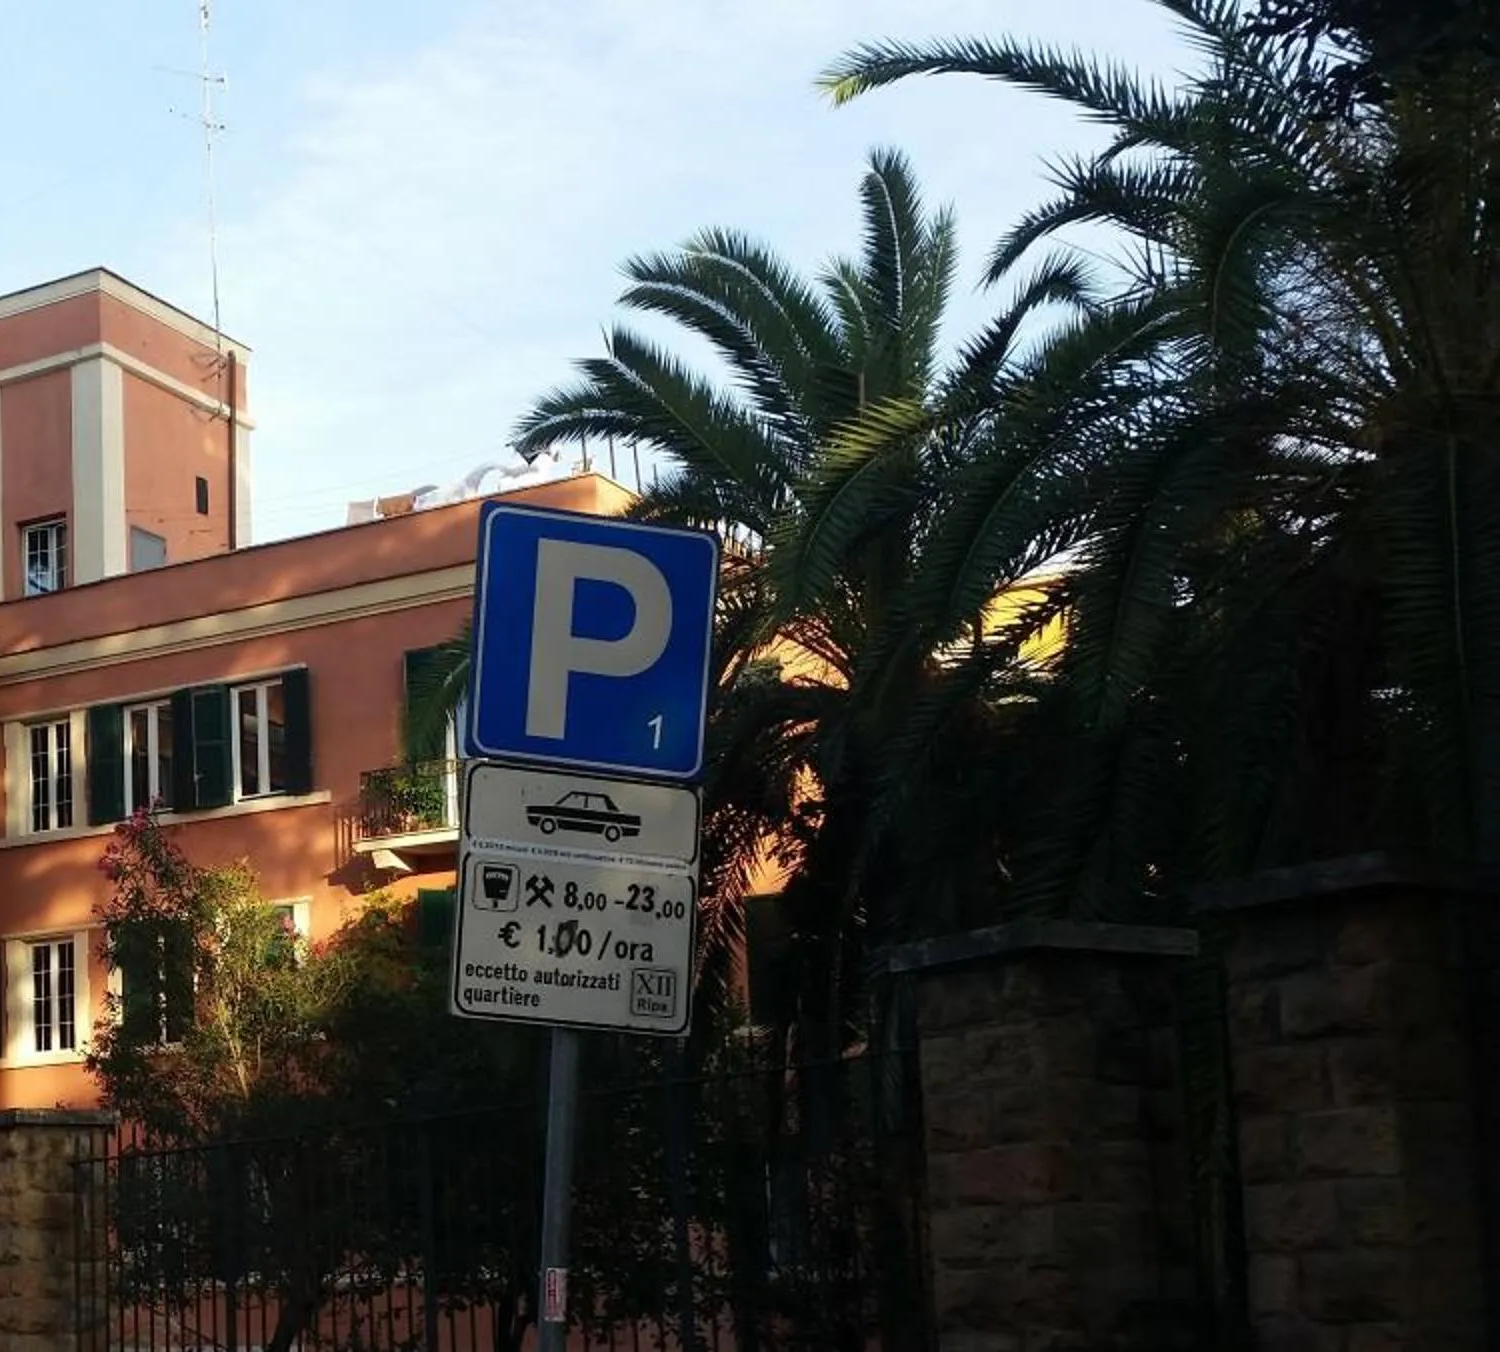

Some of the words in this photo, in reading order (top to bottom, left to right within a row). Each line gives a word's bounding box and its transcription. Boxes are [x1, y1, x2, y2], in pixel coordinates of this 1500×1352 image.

[525, 537, 673, 740] P
[647, 714, 663, 750] 1
[498, 920, 521, 948] €
[465, 963, 528, 982] eccetto
[533, 968, 621, 991] autorizzati
[637, 974, 671, 997] XII
[463, 986, 541, 1007] quartiere
[637, 1000, 668, 1013] Ripa
